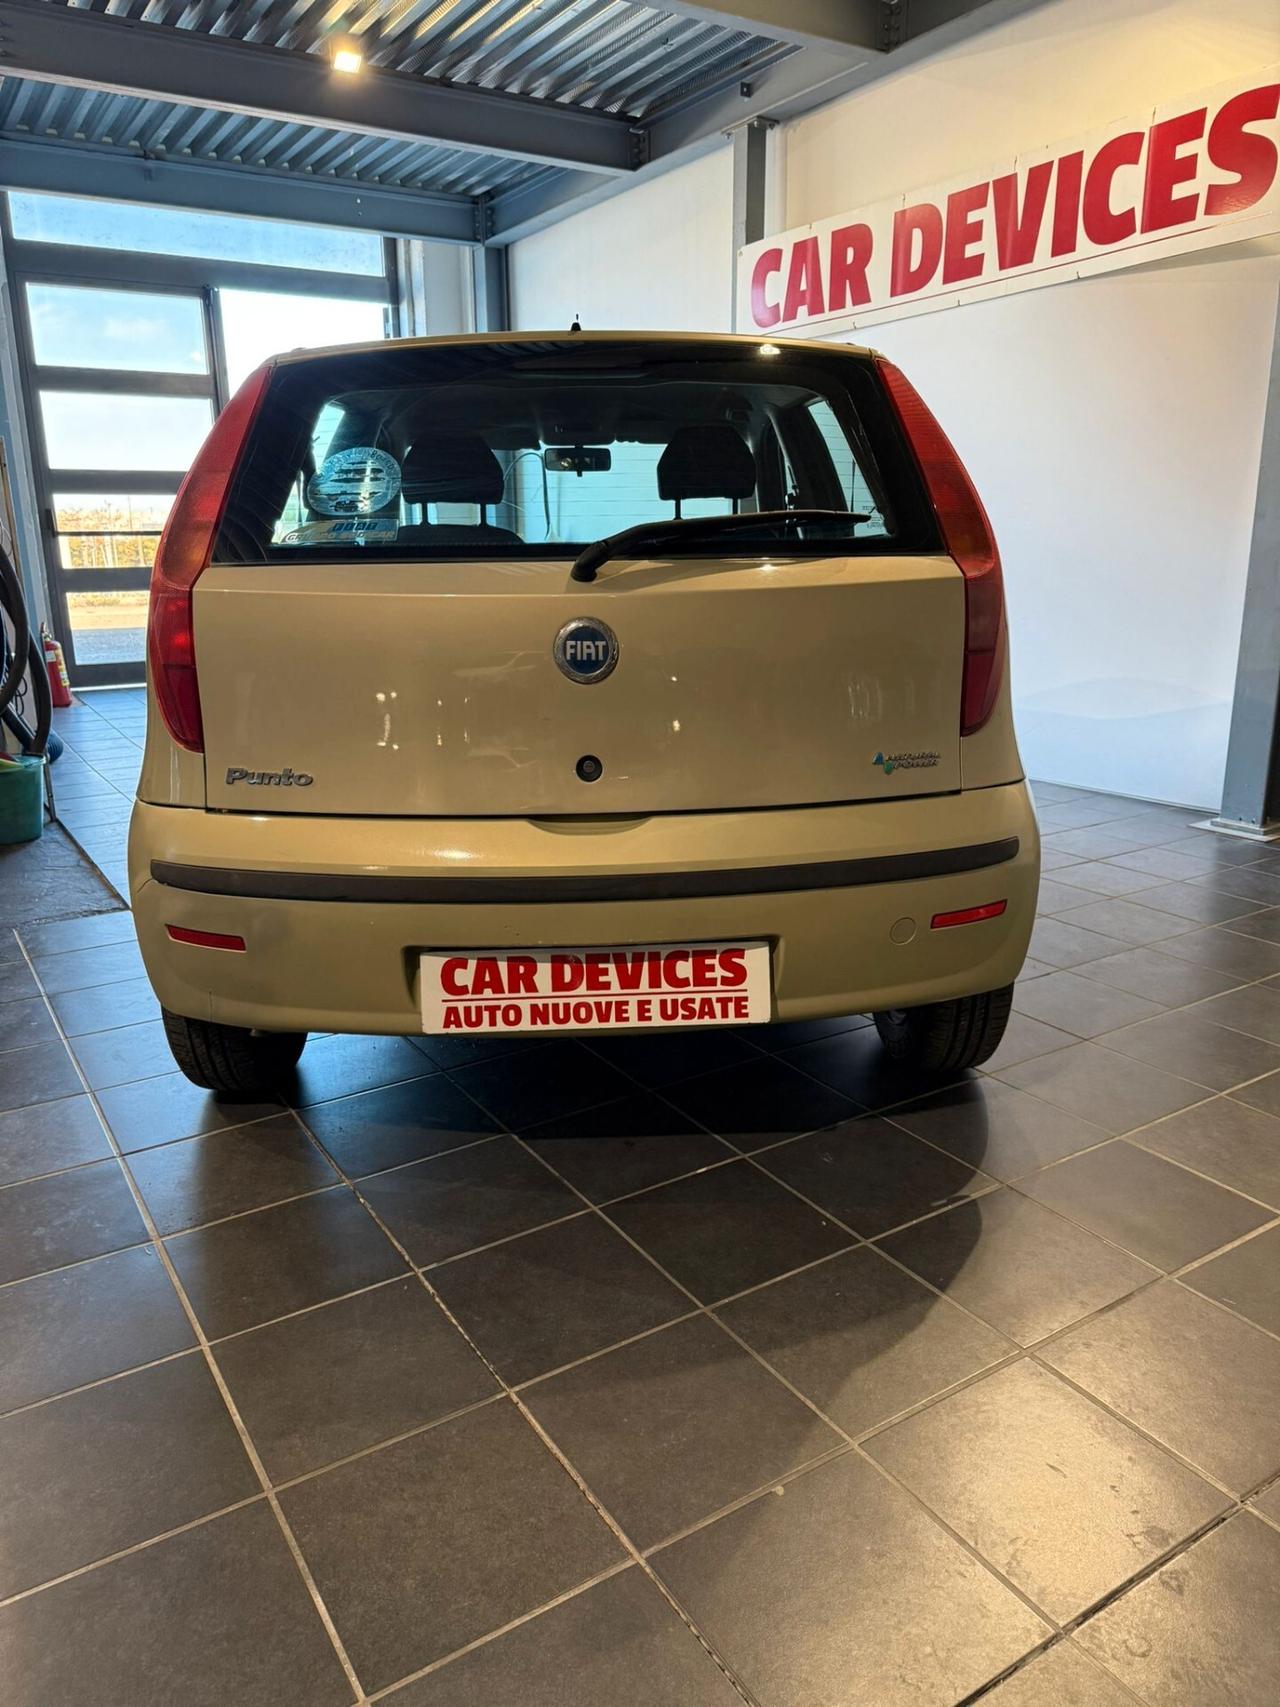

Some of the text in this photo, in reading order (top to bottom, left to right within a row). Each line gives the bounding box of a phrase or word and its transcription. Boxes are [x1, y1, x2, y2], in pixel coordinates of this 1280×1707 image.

[750, 82, 1280, 329] CAR DEVICES
[565, 640, 607, 661] FIAT
[225, 767, 314, 787] Punto
[440, 947, 748, 997] CAR DEVICES
[442, 995, 750, 1029] AUTO NUOVE E USATE
